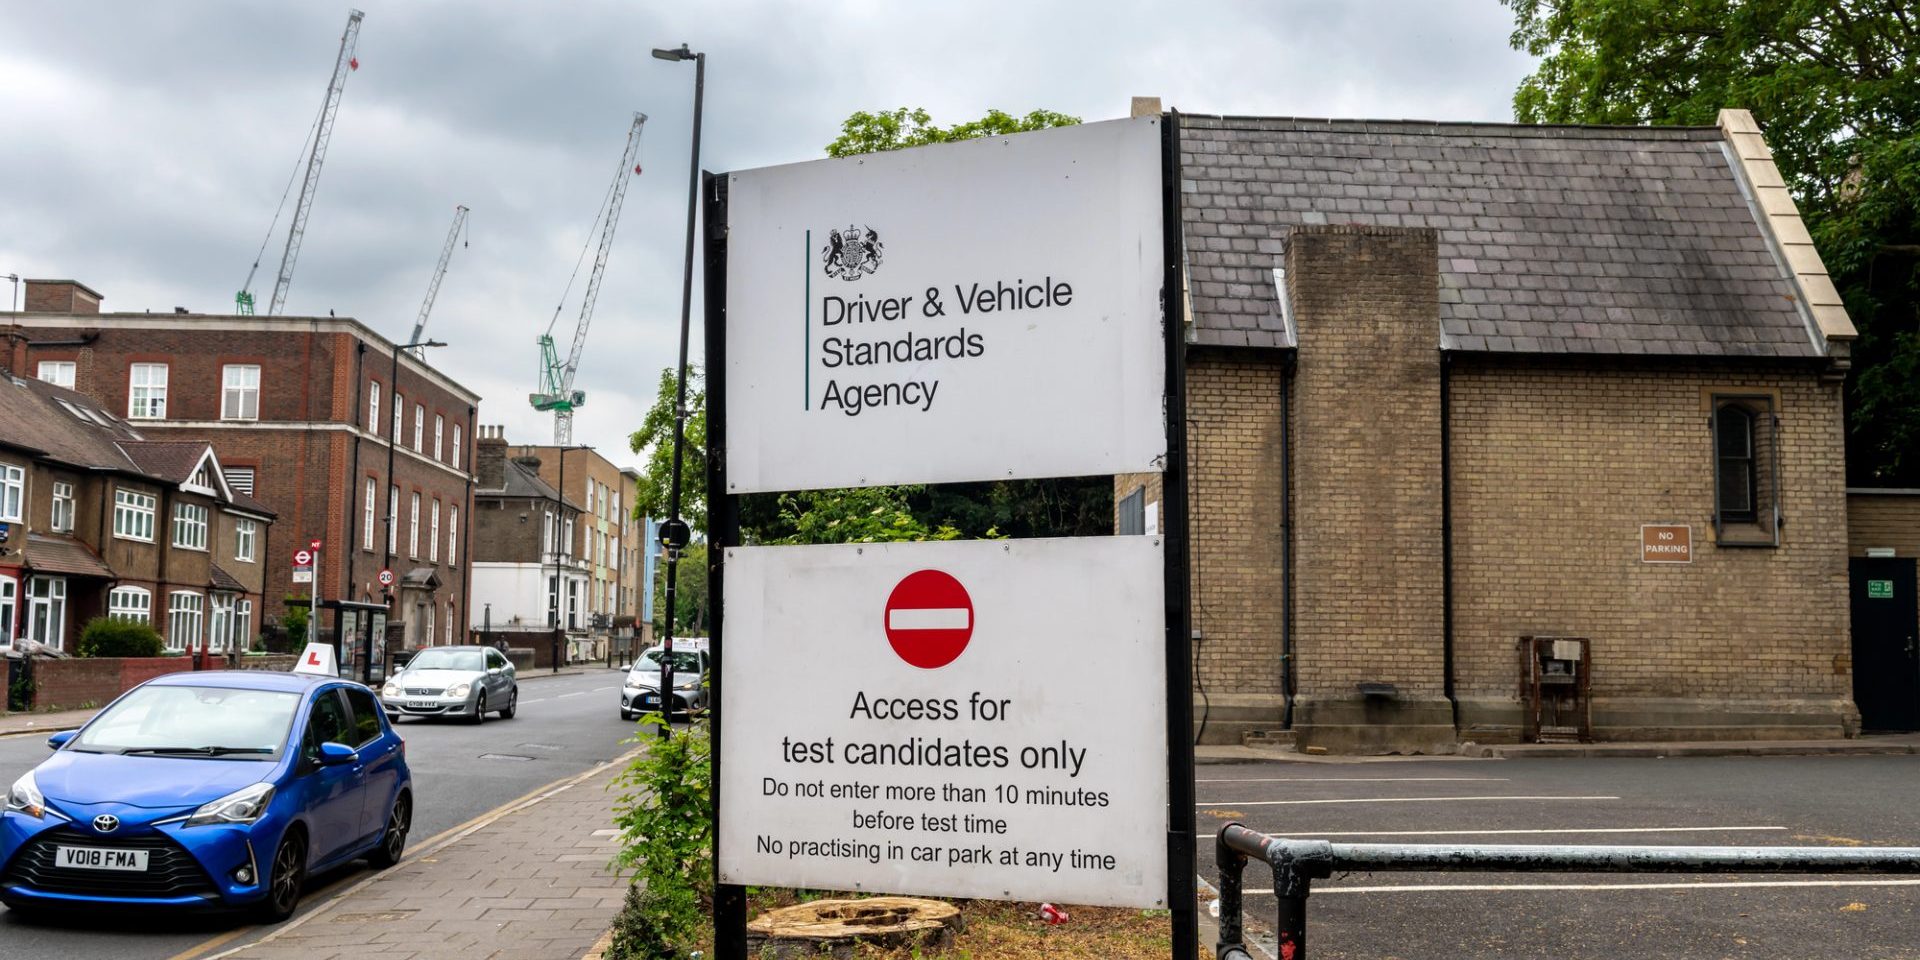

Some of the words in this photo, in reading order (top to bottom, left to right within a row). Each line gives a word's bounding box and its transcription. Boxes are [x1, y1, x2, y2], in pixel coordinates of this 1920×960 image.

[823, 293, 913, 327] Driver
[922, 286, 946, 318] &
[954, 276, 1073, 315] Vehicle
[821, 327, 985, 368] Standards
[820, 379, 939, 417] Agency
[1645, 545, 1688, 553] PARKING
[1658, 532, 1674, 540] NO
[308, 651, 321, 665] L
[849, 691, 959, 721] Access
[969, 691, 1012, 722] for
[782, 736, 835, 765] test
[844, 737, 1009, 768] candidates
[1020, 739, 1087, 778] only
[763, 777, 789, 797] Do
[795, 780, 825, 798] not
[830, 781, 880, 800] enter
[887, 785, 936, 802] more
[942, 782, 986, 803] than
[995, 784, 1019, 804] 10
[1026, 785, 1110, 807] minutes
[853, 809, 915, 832] before
[922, 813, 958, 833] test
[964, 814, 1007, 835] time
[105, 851, 136, 867] FMA
[757, 834, 783, 855] No
[789, 839, 880, 864] practising
[887, 841, 904, 860] in
[911, 846, 943, 862] car
[948, 844, 993, 868] park
[999, 846, 1019, 866] at
[1025, 851, 1064, 873] any
[1070, 849, 1116, 871] time
